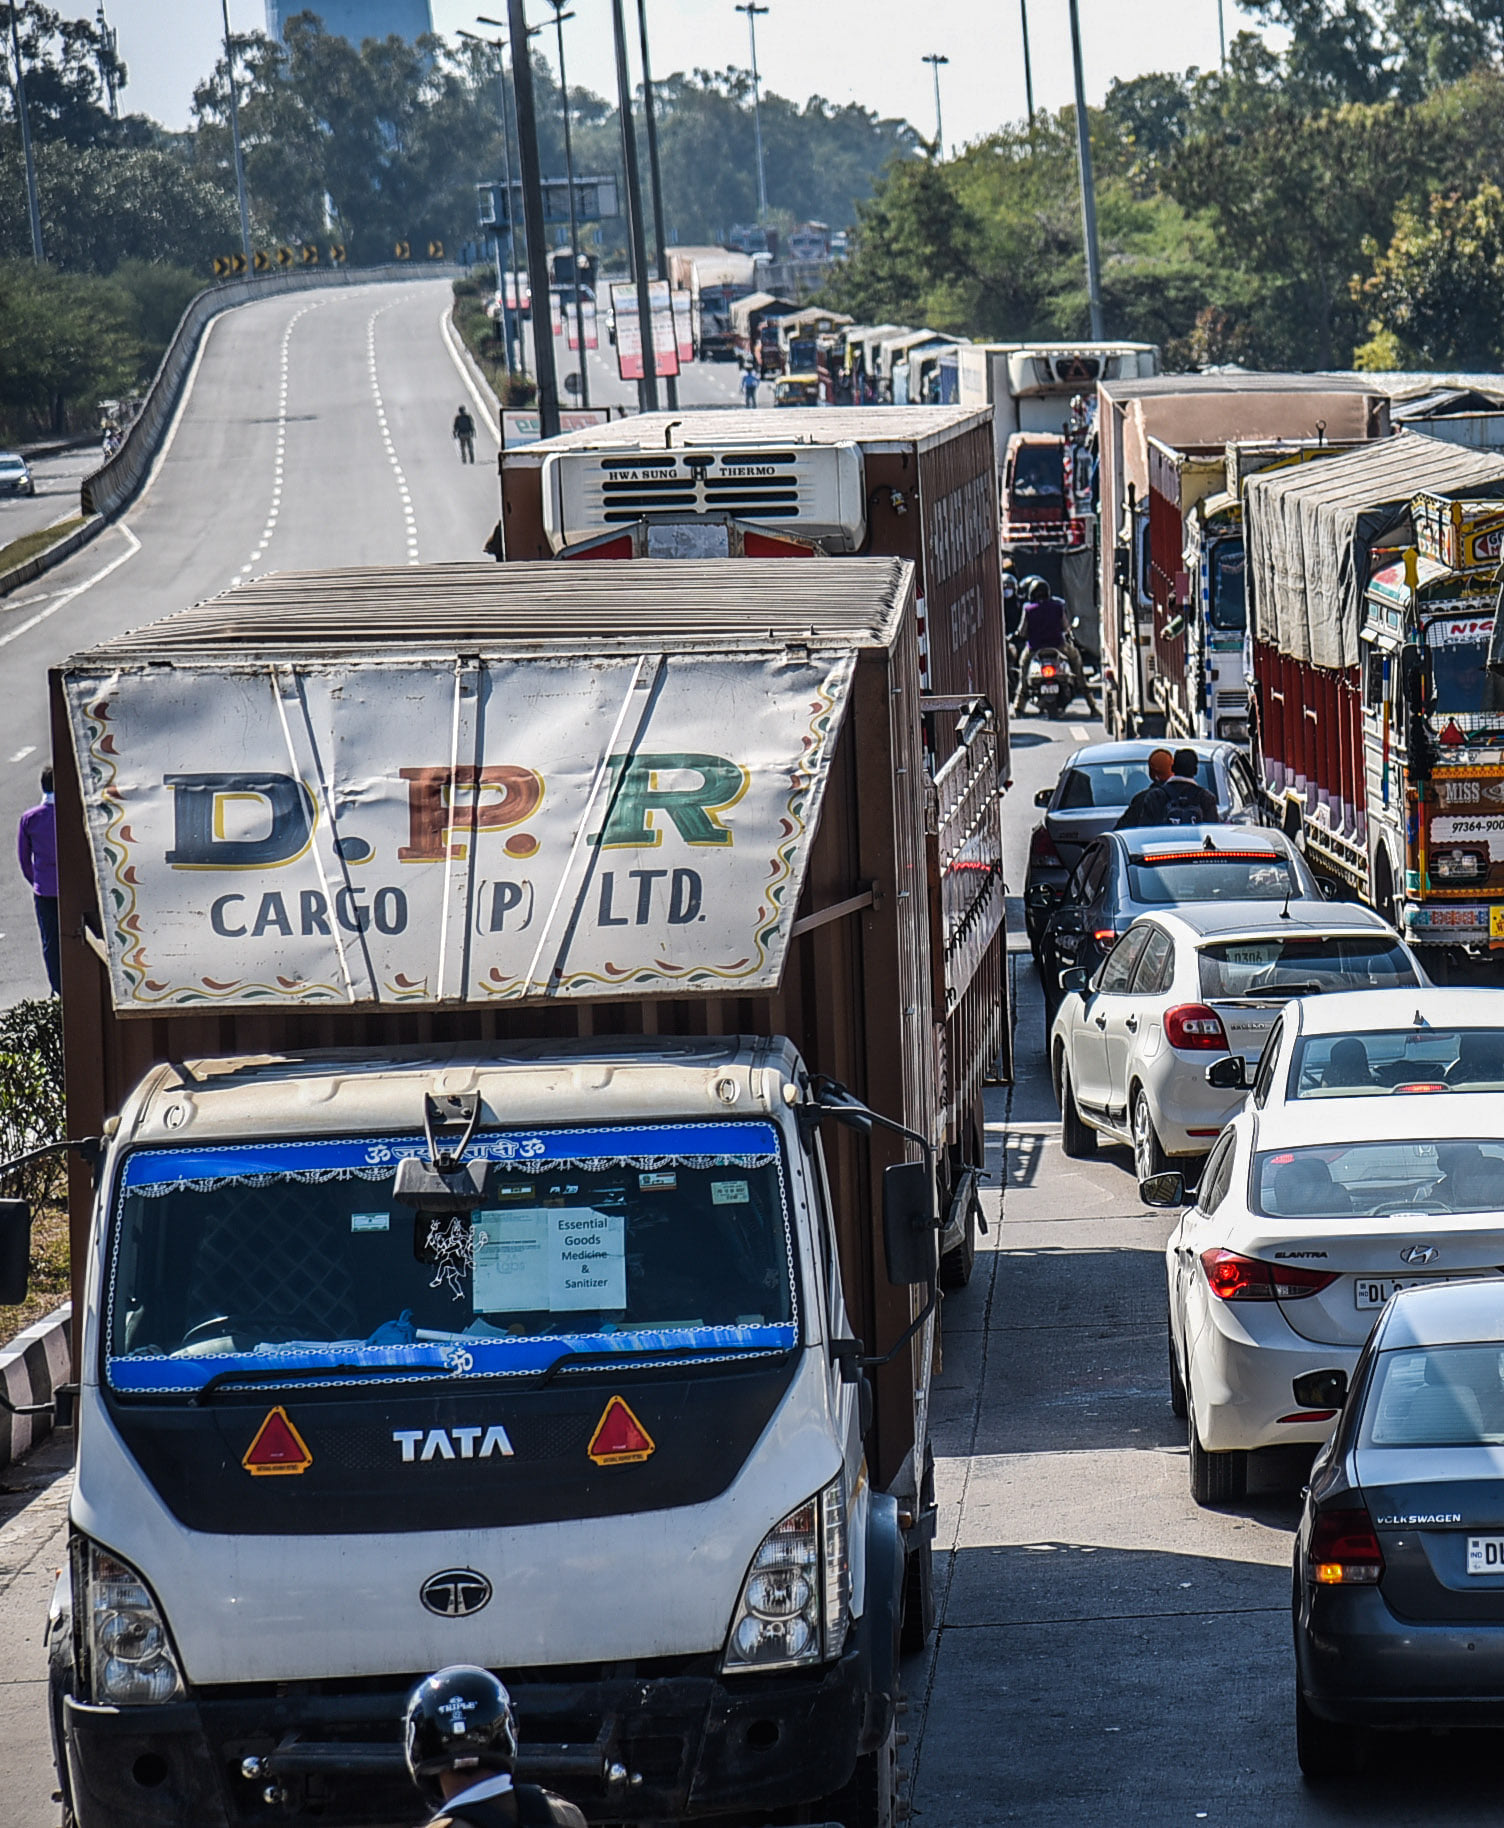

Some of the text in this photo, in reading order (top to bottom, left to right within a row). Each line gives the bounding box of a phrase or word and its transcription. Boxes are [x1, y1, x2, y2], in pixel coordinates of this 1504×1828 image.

[609, 471, 638, 481] HWA
[642, 469, 678, 479] SUNG
[719, 466, 776, 477] THERMO
[1445, 782, 1480, 801] MISS
[210, 867, 707, 938] CARGO (P) LTD.
[558, 1218, 608, 1231] Essential
[564, 1235, 601, 1247] Goods
[561, 1250, 608, 1261] Medicine
[1274, 1251, 1328, 1259] ELANTRA
[581, 1264, 590, 1275] &
[565, 1278, 608, 1290] Sanitizer
[392, 1425, 515, 1462] TATA
[1376, 1513, 1462, 1525] VOLKSWAGEN
